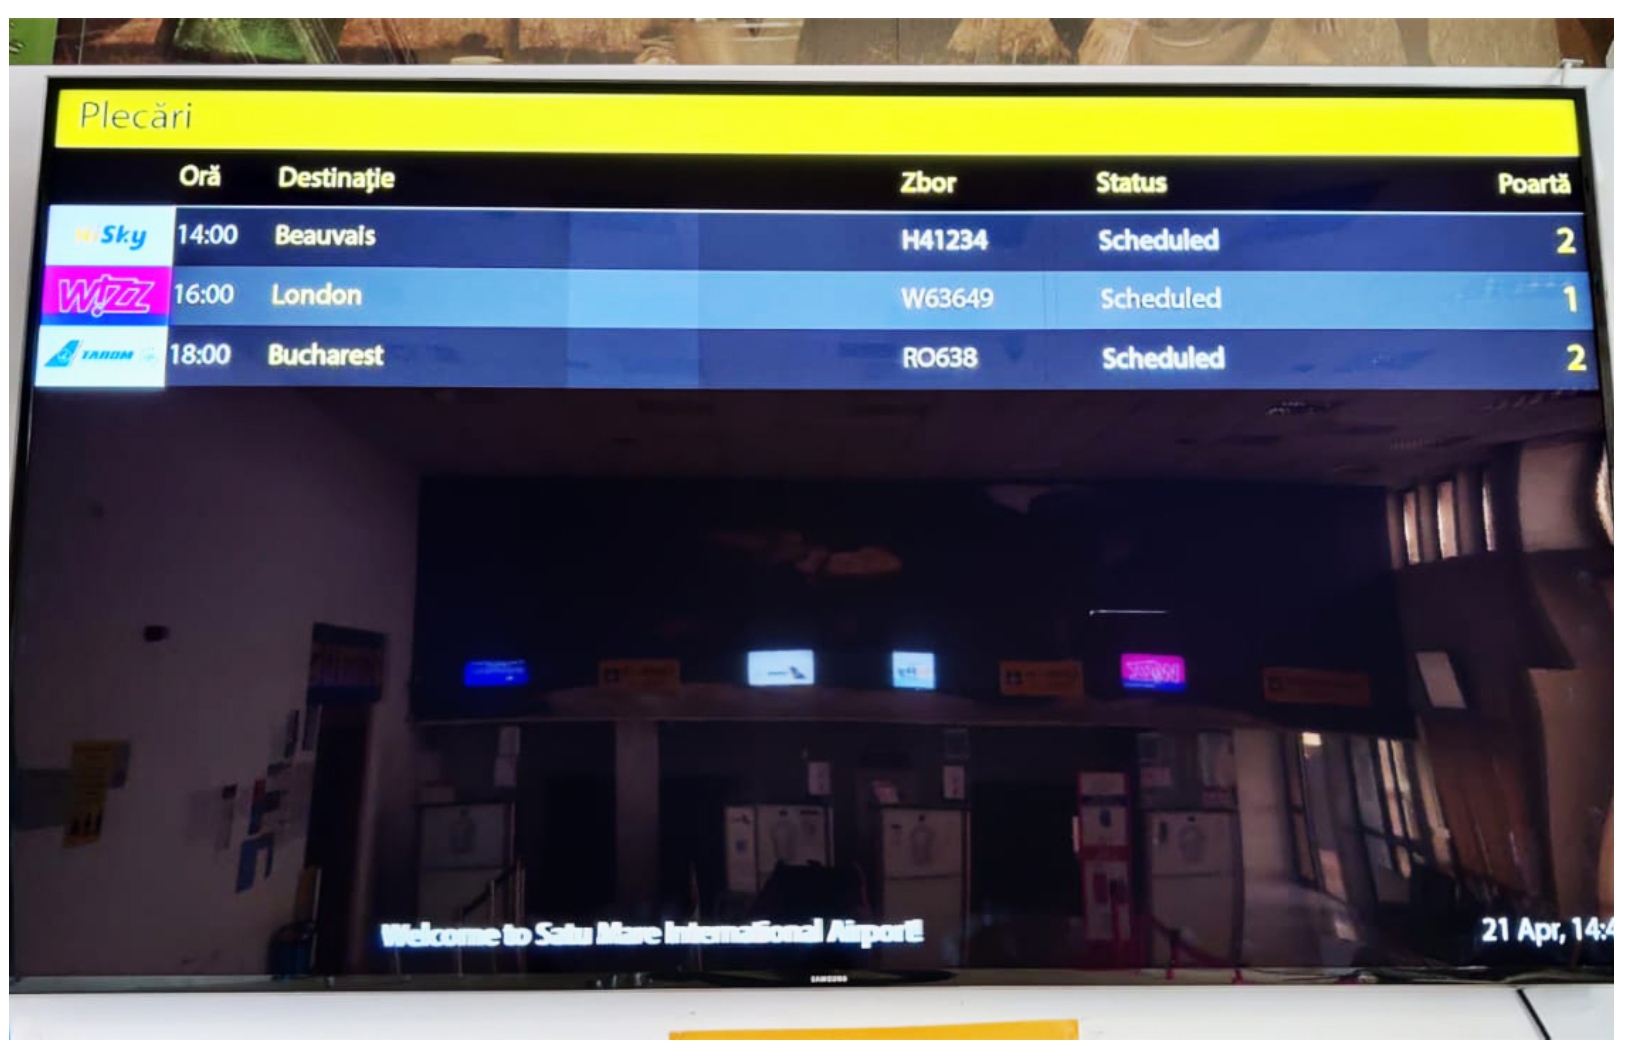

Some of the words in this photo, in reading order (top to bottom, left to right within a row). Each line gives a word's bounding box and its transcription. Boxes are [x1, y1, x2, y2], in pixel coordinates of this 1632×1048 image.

[79, 100, 193, 130] Plecări
[179, 164, 222, 187] Oră
[900, 170, 958, 193] Zbor
[1096, 171, 1168, 194] Status
[1497, 172, 1573, 195] Poartă
[177, 223, 239, 245] 14:00
[274, 223, 377, 247] Beauvais
[901, 228, 990, 251] H41234
[1098, 227, 1221, 252] Scheduled
[1556, 226, 1577, 254] 2
[174, 283, 235, 305] 16:00
[271, 282, 363, 306] London
[901, 287, 995, 309] W63649
[1100, 286, 1222, 310] Scheduled
[1563, 285, 1578, 313] 1
[81, 349, 135, 361] TAROM
[170, 343, 231, 366] 18:00
[268, 342, 385, 366] Bucharest
[903, 346, 980, 369] RO638
[1102, 345, 1226, 370] Scheduled
[1567, 343, 1588, 371] 2
[380, 921, 501, 947] Welcome
[502, 922, 533, 946] to
[534, 921, 594, 946] Satu
[595, 921, 663, 945] Mare
[664, 918, 824, 944] International
[1481, 917, 1509, 942] 21
[1517, 917, 1566, 948] Apr,
